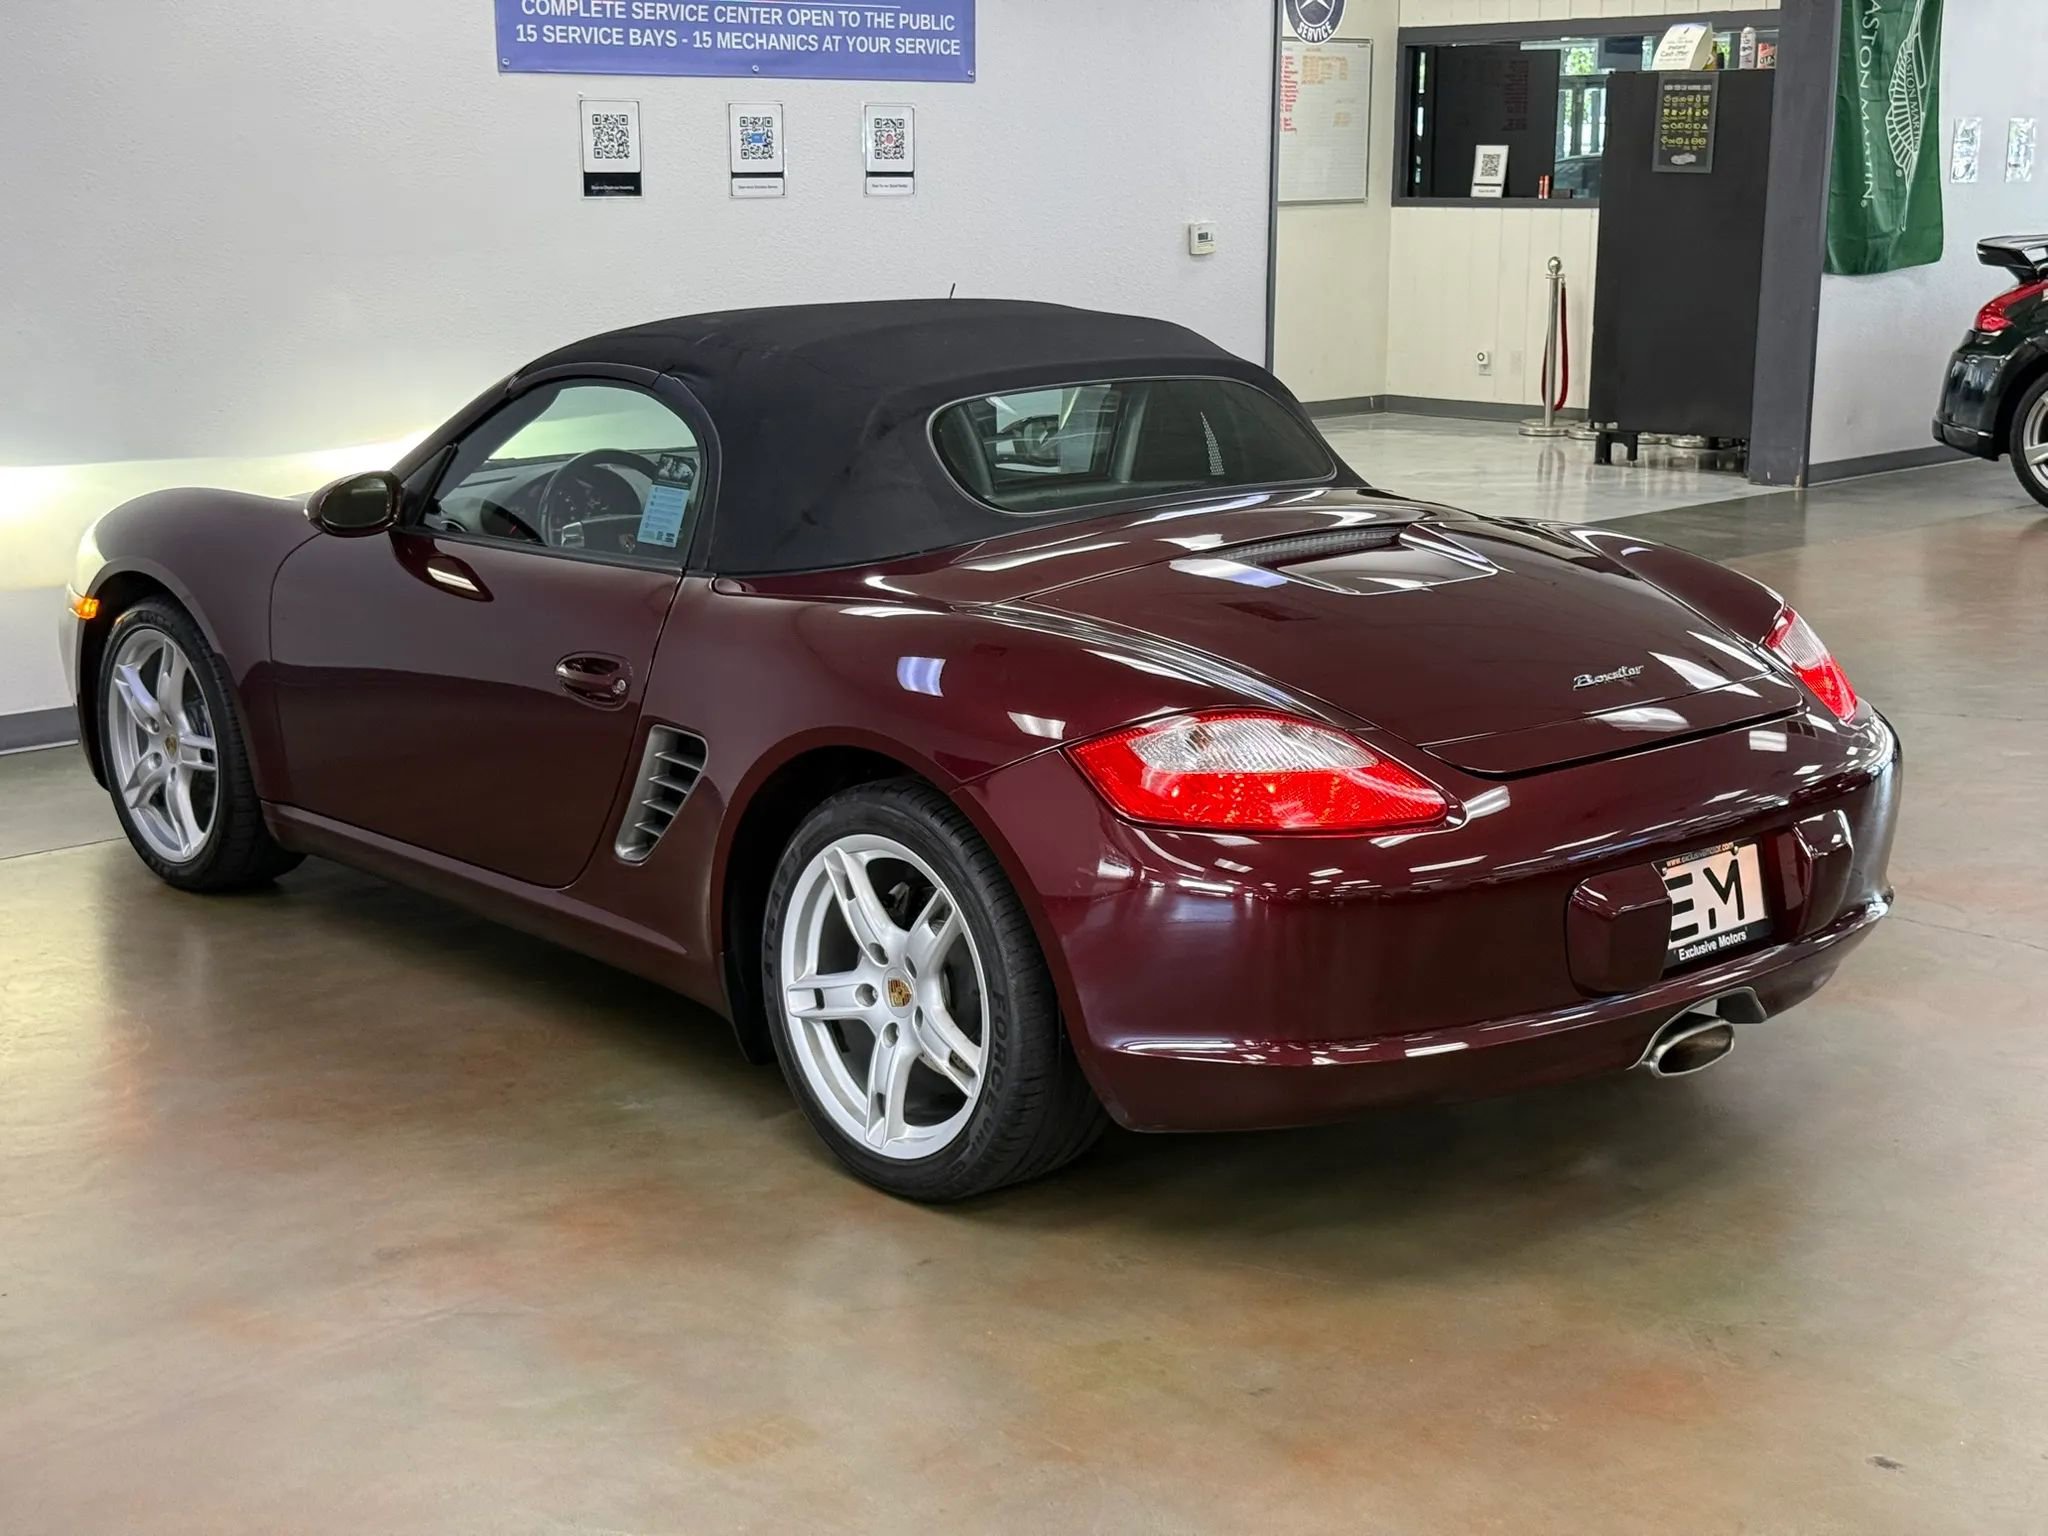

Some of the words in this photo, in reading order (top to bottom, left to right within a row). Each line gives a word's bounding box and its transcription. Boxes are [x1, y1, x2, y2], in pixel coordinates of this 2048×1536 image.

[521, 0, 626, 19] COMPLETE
[631, 2, 709, 22] SERVICE
[713, 5, 782, 25] CENTER
[787, 8, 834, 27] OPEN
[838, 11, 861, 28] TO
[864, 12, 895, 29] THE
[899, 13, 956, 31] PUBLIC
[1297, 21, 1333, 41] SERVICE
[516, 24, 538, 42] 15
[542, 25, 625, 45] SERVICE
[629, 28, 678, 47] BAYS
[692, 31, 712, 48] 15
[716, 32, 818, 51] MECHANICS
[822, 35, 842, 52] AT
[846, 36, 891, 53] YOUR
[895, 37, 961, 55] SERVICE
[1860, 0, 1881, 88] ASTON
[1904, 53, 1917, 97] ASTON
[1678, 939, 1718, 961] Exclusive
[1718, 930, 1747, 948] Motors
[985, 989, 1008, 1107] FORCE
